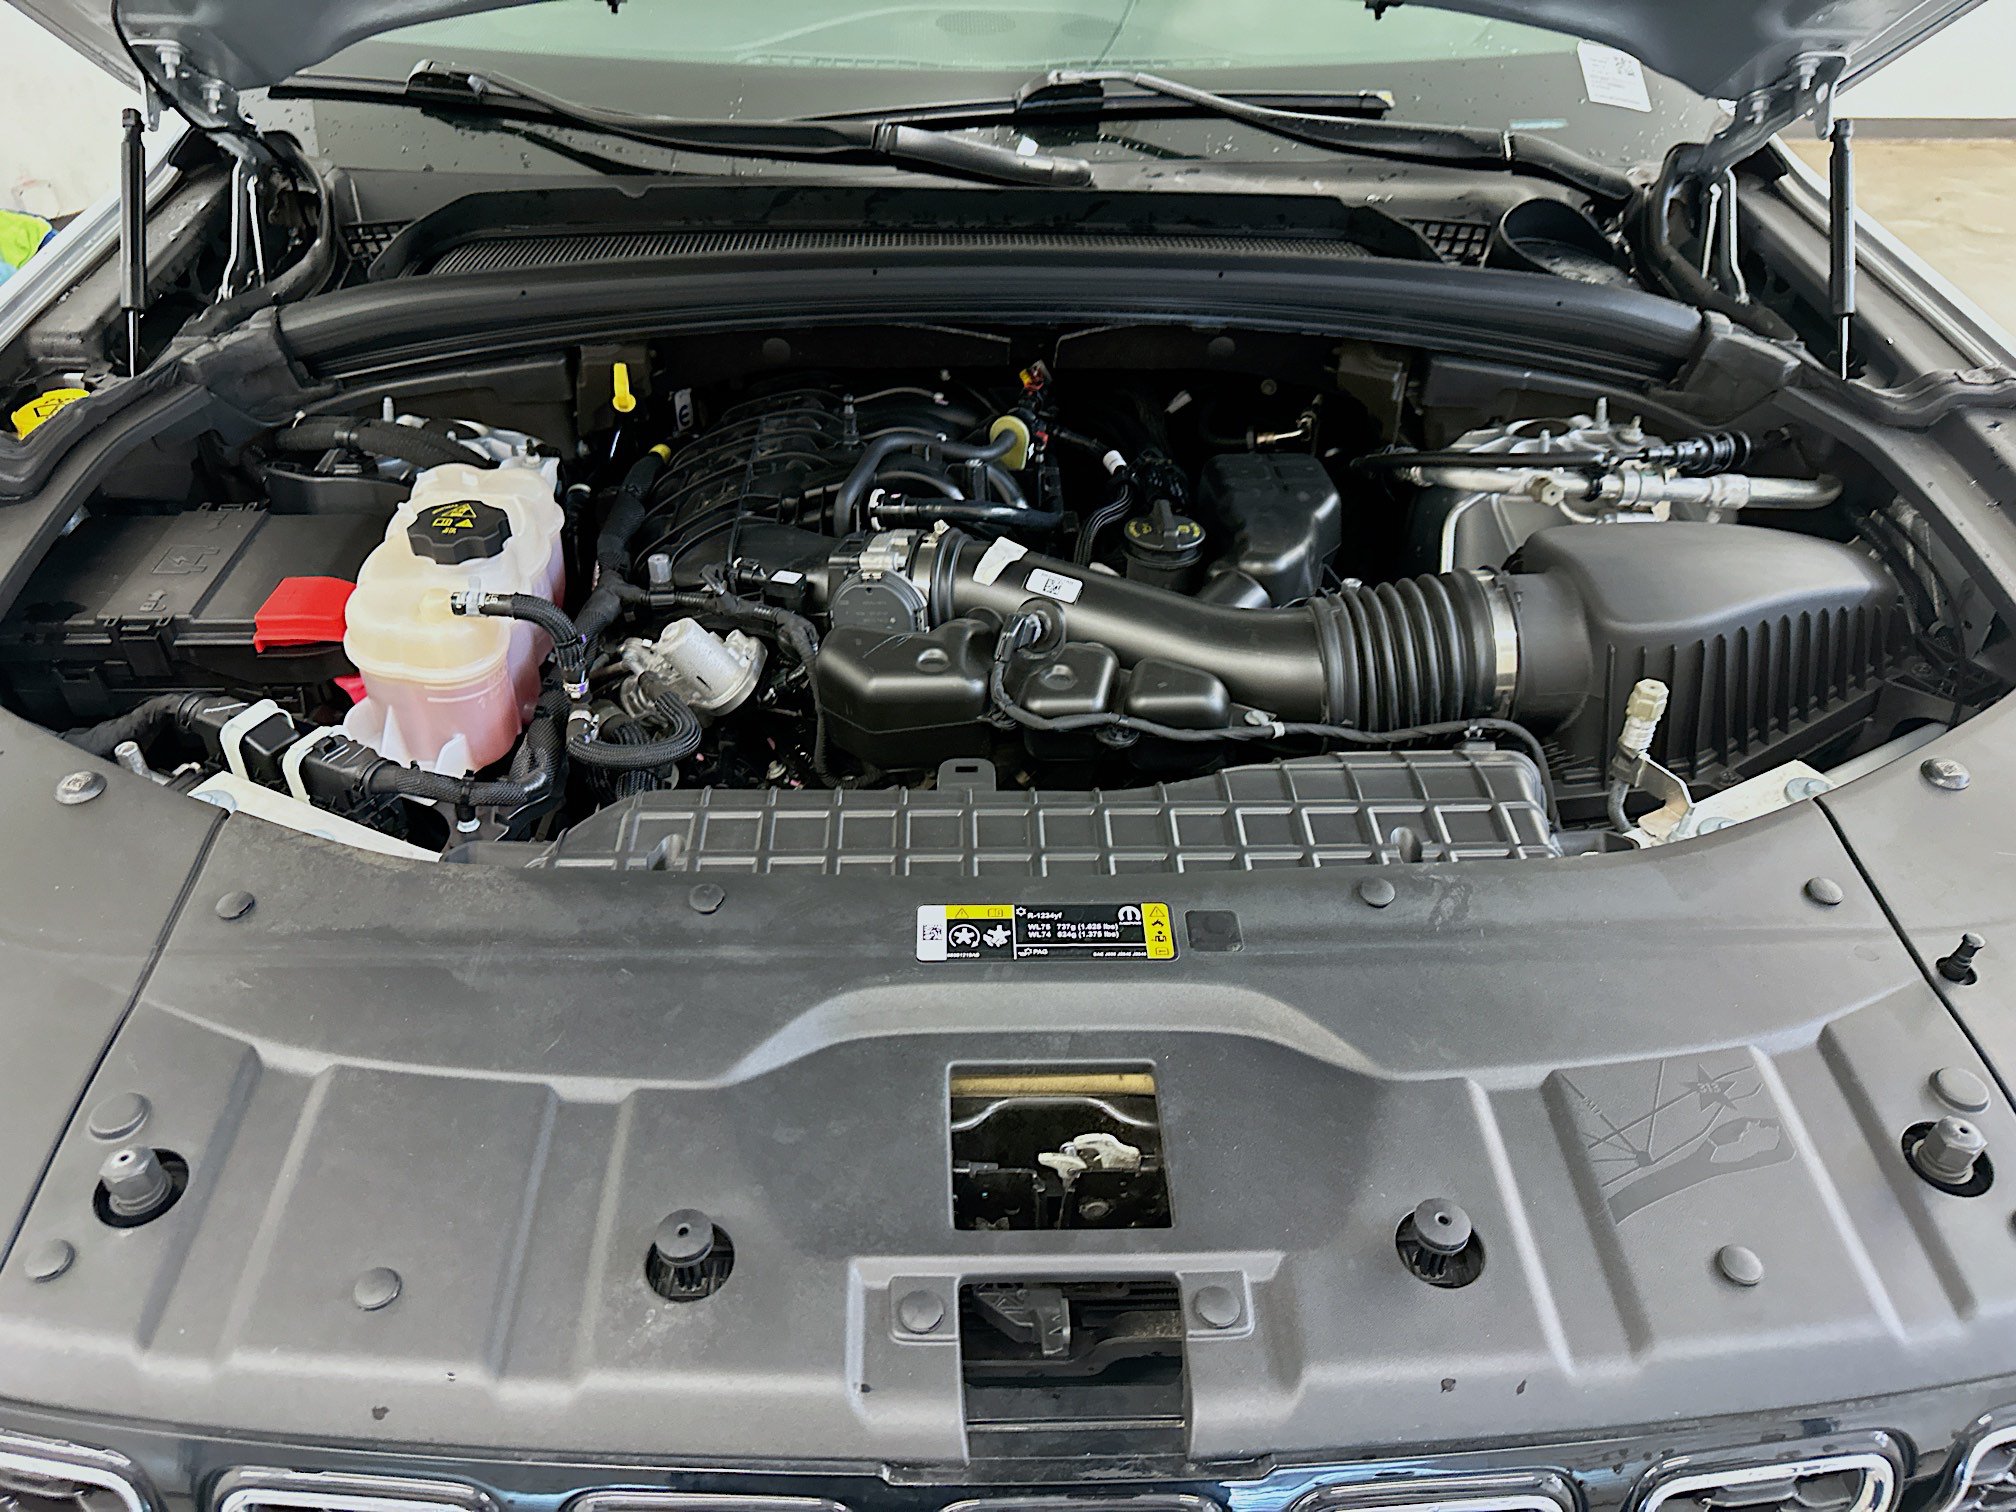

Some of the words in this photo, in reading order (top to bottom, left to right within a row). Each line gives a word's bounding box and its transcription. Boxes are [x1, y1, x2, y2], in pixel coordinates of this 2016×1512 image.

[1027, 912, 1062, 920] R-1234yf
[1056, 923, 1076, 931] 737g
[1103, 923, 1119, 931] lbs)
[1103, 931, 1120, 939] lbs)
